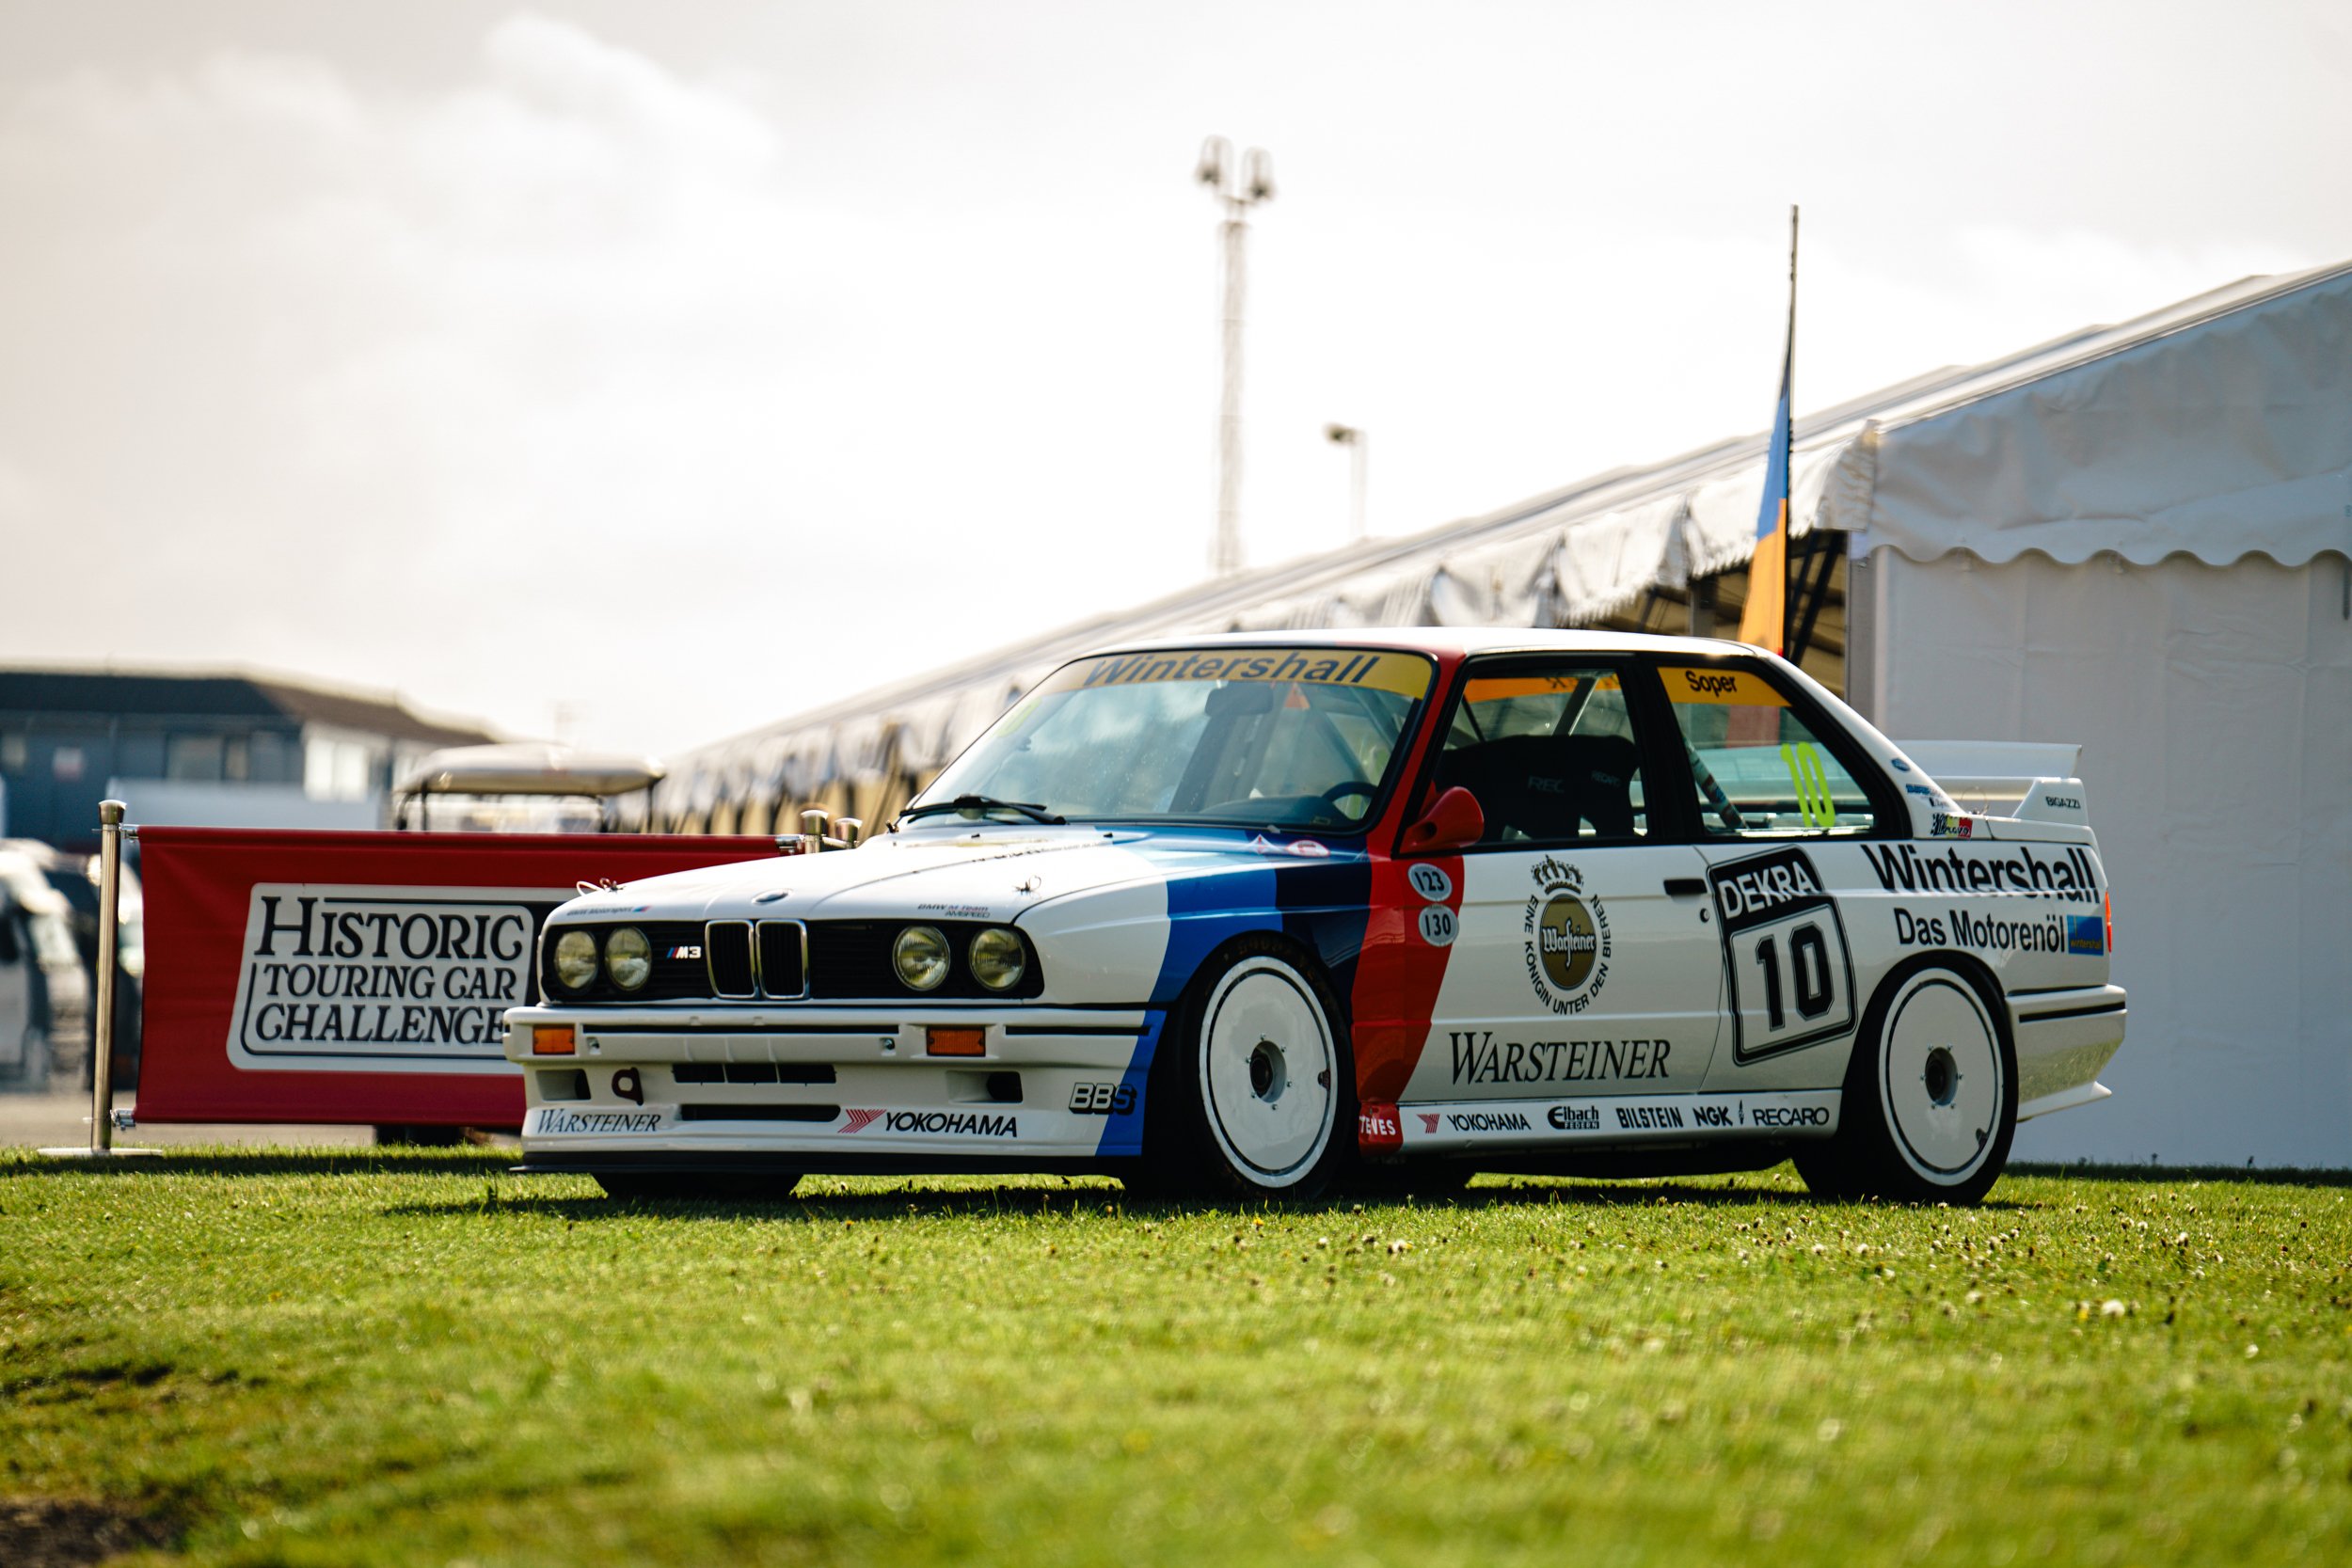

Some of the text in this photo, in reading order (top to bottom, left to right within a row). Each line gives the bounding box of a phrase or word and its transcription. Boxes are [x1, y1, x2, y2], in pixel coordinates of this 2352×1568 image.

[1083, 651, 1380, 687] Wintershall
[1685, 670, 1738, 698] Soper
[1780, 741, 1836, 828] 10
[2045, 796, 2081, 809] BIGAZZI
[1414, 871, 1445, 892] 123
[1860, 845, 2100, 903] Wintershall
[1718, 861, 1819, 919] DEKRA
[254, 896, 524, 960] HISTORIC
[1424, 913, 1452, 937] 130
[1894, 908, 2065, 952] Das Motorenöl
[675, 945, 702, 959] M3
[1524, 894, 1611, 1015] EINE KÖNIGIN UNTER DEN BIEREN
[263, 963, 516, 1000] TOURING CAR
[1756, 921, 1836, 1032] 10
[256, 1003, 504, 1044] CHALLENGE
[1449, 1031, 1671, 1085] WARSTEINER
[1069, 1082, 1137, 1114] BBS
[537, 1108, 661, 1134] WARSTEINER
[885, 1112, 1017, 1137] YOKOHAMA
[1359, 1114, 1396, 1135] TEVES
[1447, 1113, 1532, 1132] YOKOHAMA
[1548, 1105, 1599, 1129] Eibach
[1615, 1107, 1684, 1129] BILSTEIN
[1692, 1105, 1733, 1127] NGK
[1753, 1107, 1830, 1127] RECARO
